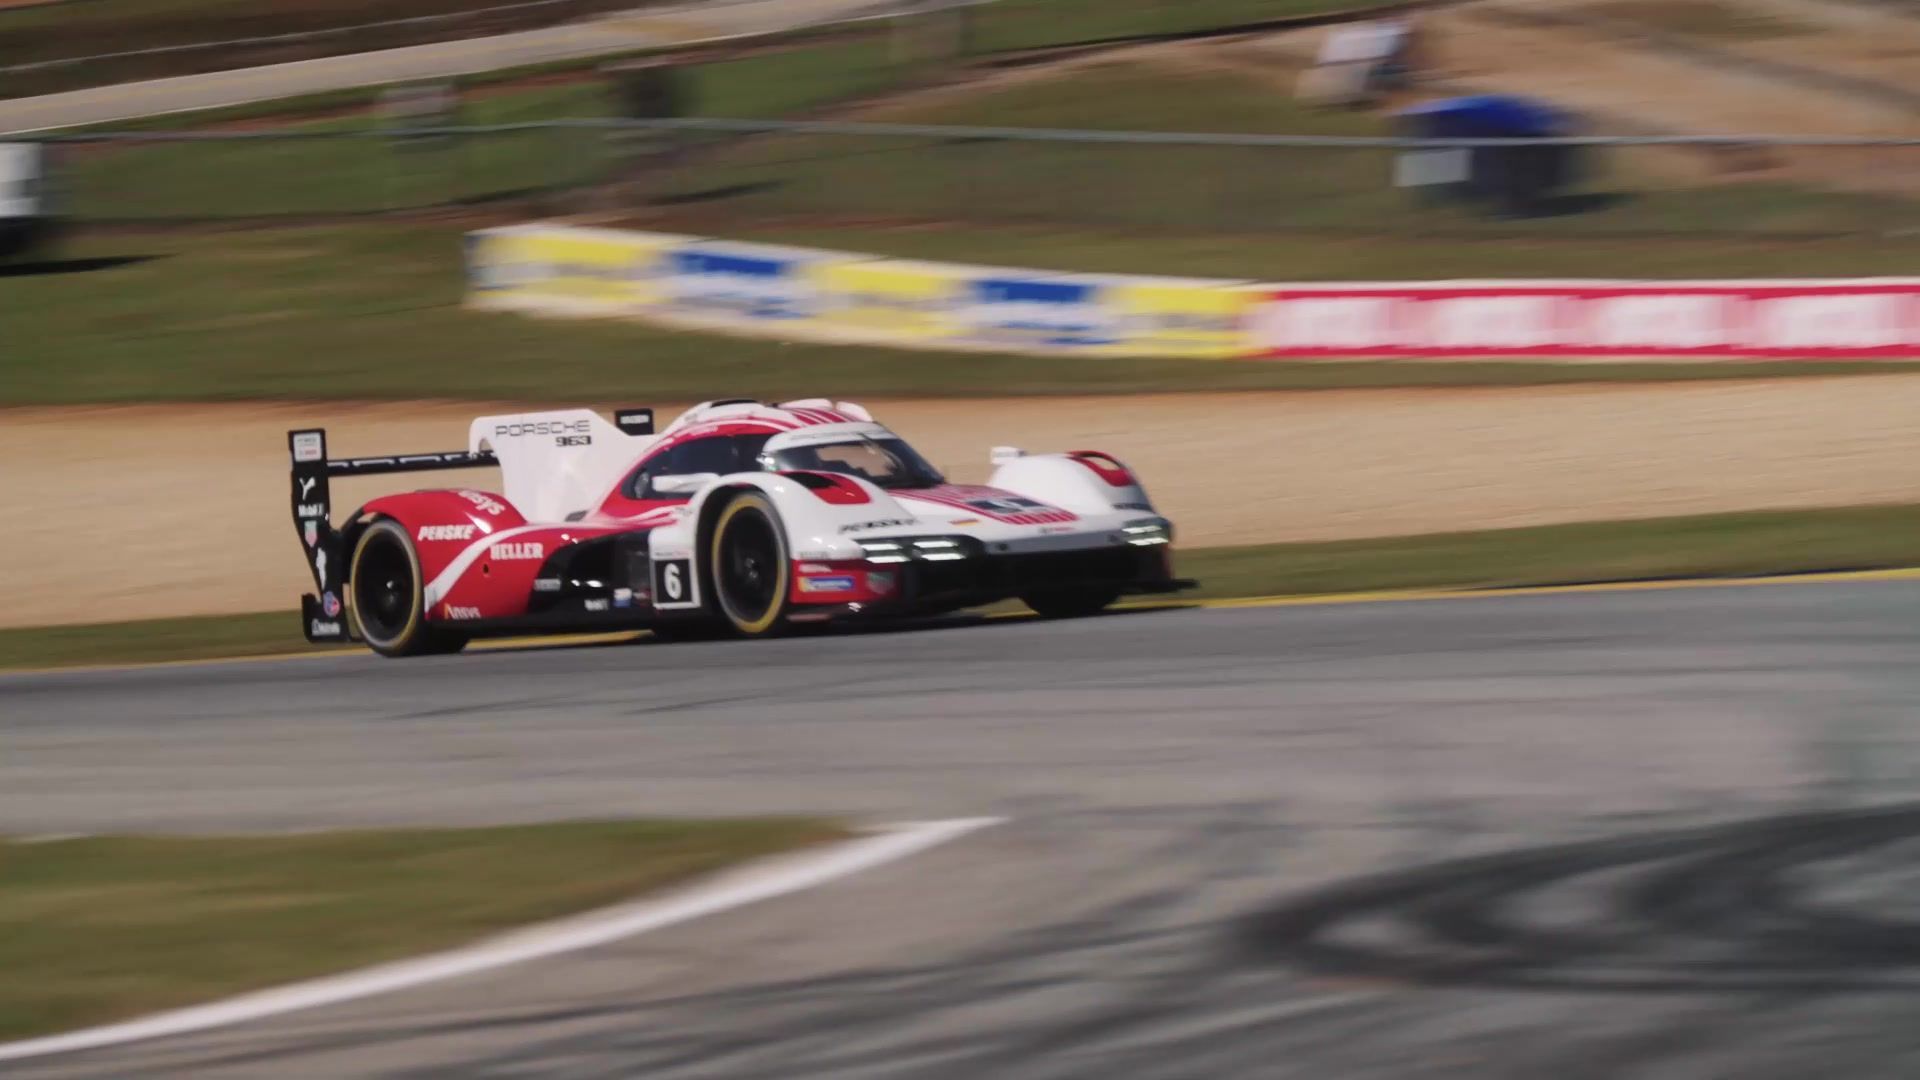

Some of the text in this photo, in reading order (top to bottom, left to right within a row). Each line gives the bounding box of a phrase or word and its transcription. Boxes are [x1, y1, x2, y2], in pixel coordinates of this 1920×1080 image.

[495, 420, 590, 437] PORSCHE
[556, 435, 592, 447] 963
[418, 524, 475, 541] PENSKE
[664, 562, 683, 600] 6
